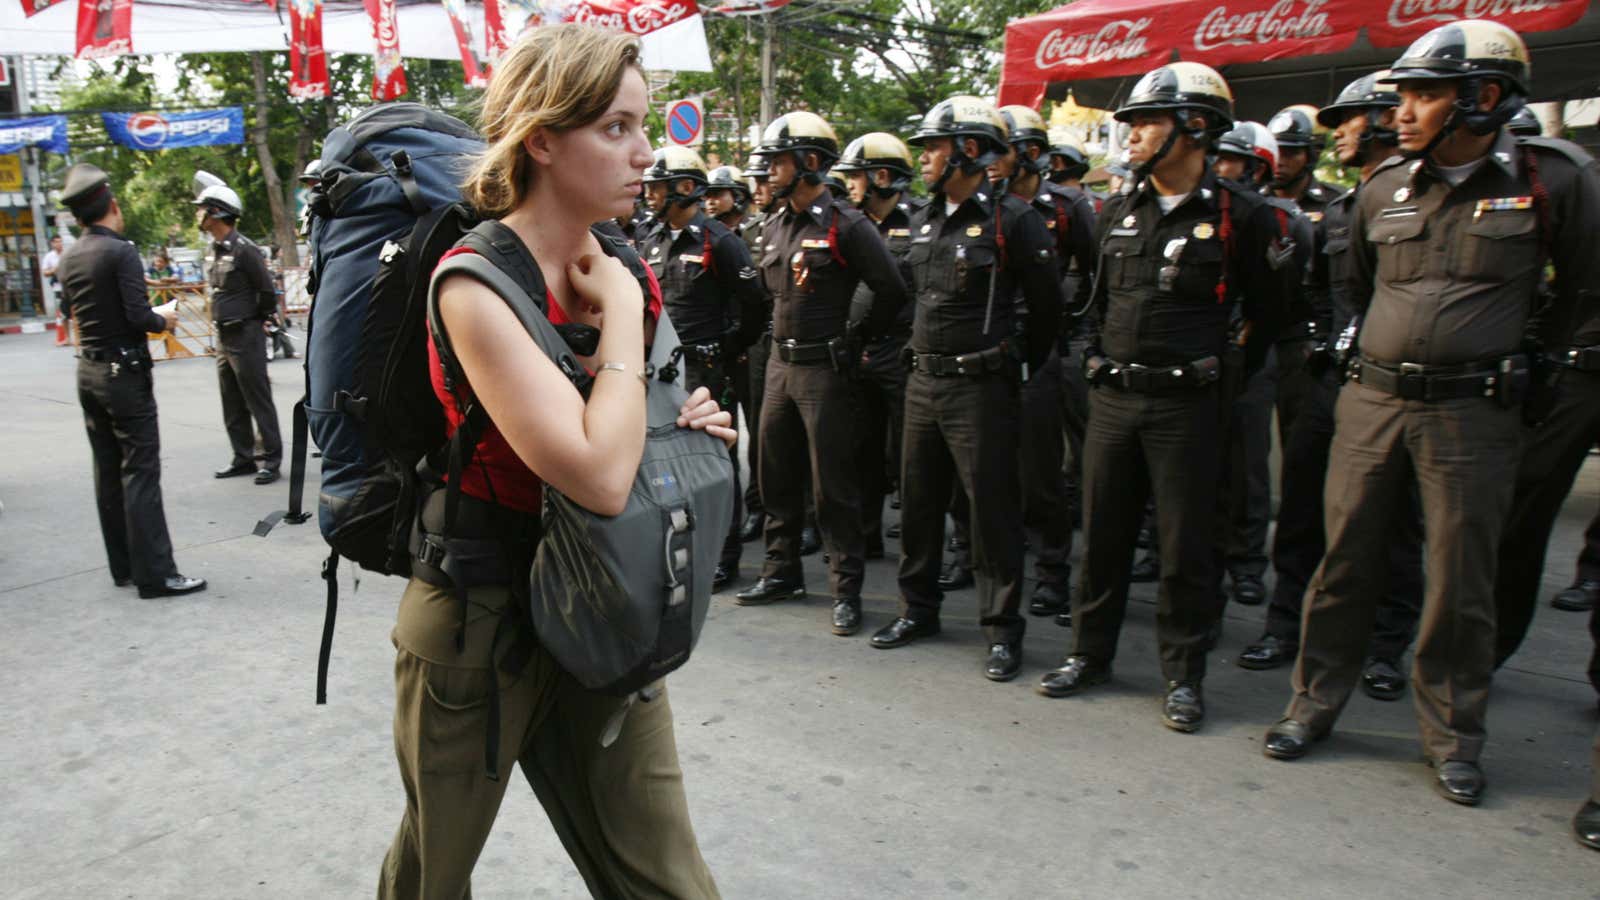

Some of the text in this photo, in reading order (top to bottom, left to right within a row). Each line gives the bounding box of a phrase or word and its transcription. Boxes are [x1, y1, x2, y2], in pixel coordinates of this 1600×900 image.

[1193, 0, 1332, 51] Coca-Cola
[1035, 17, 1153, 70] Coca-Cola
[0, 127, 53, 144] EPSI
[169, 118, 230, 137] PEPSI
